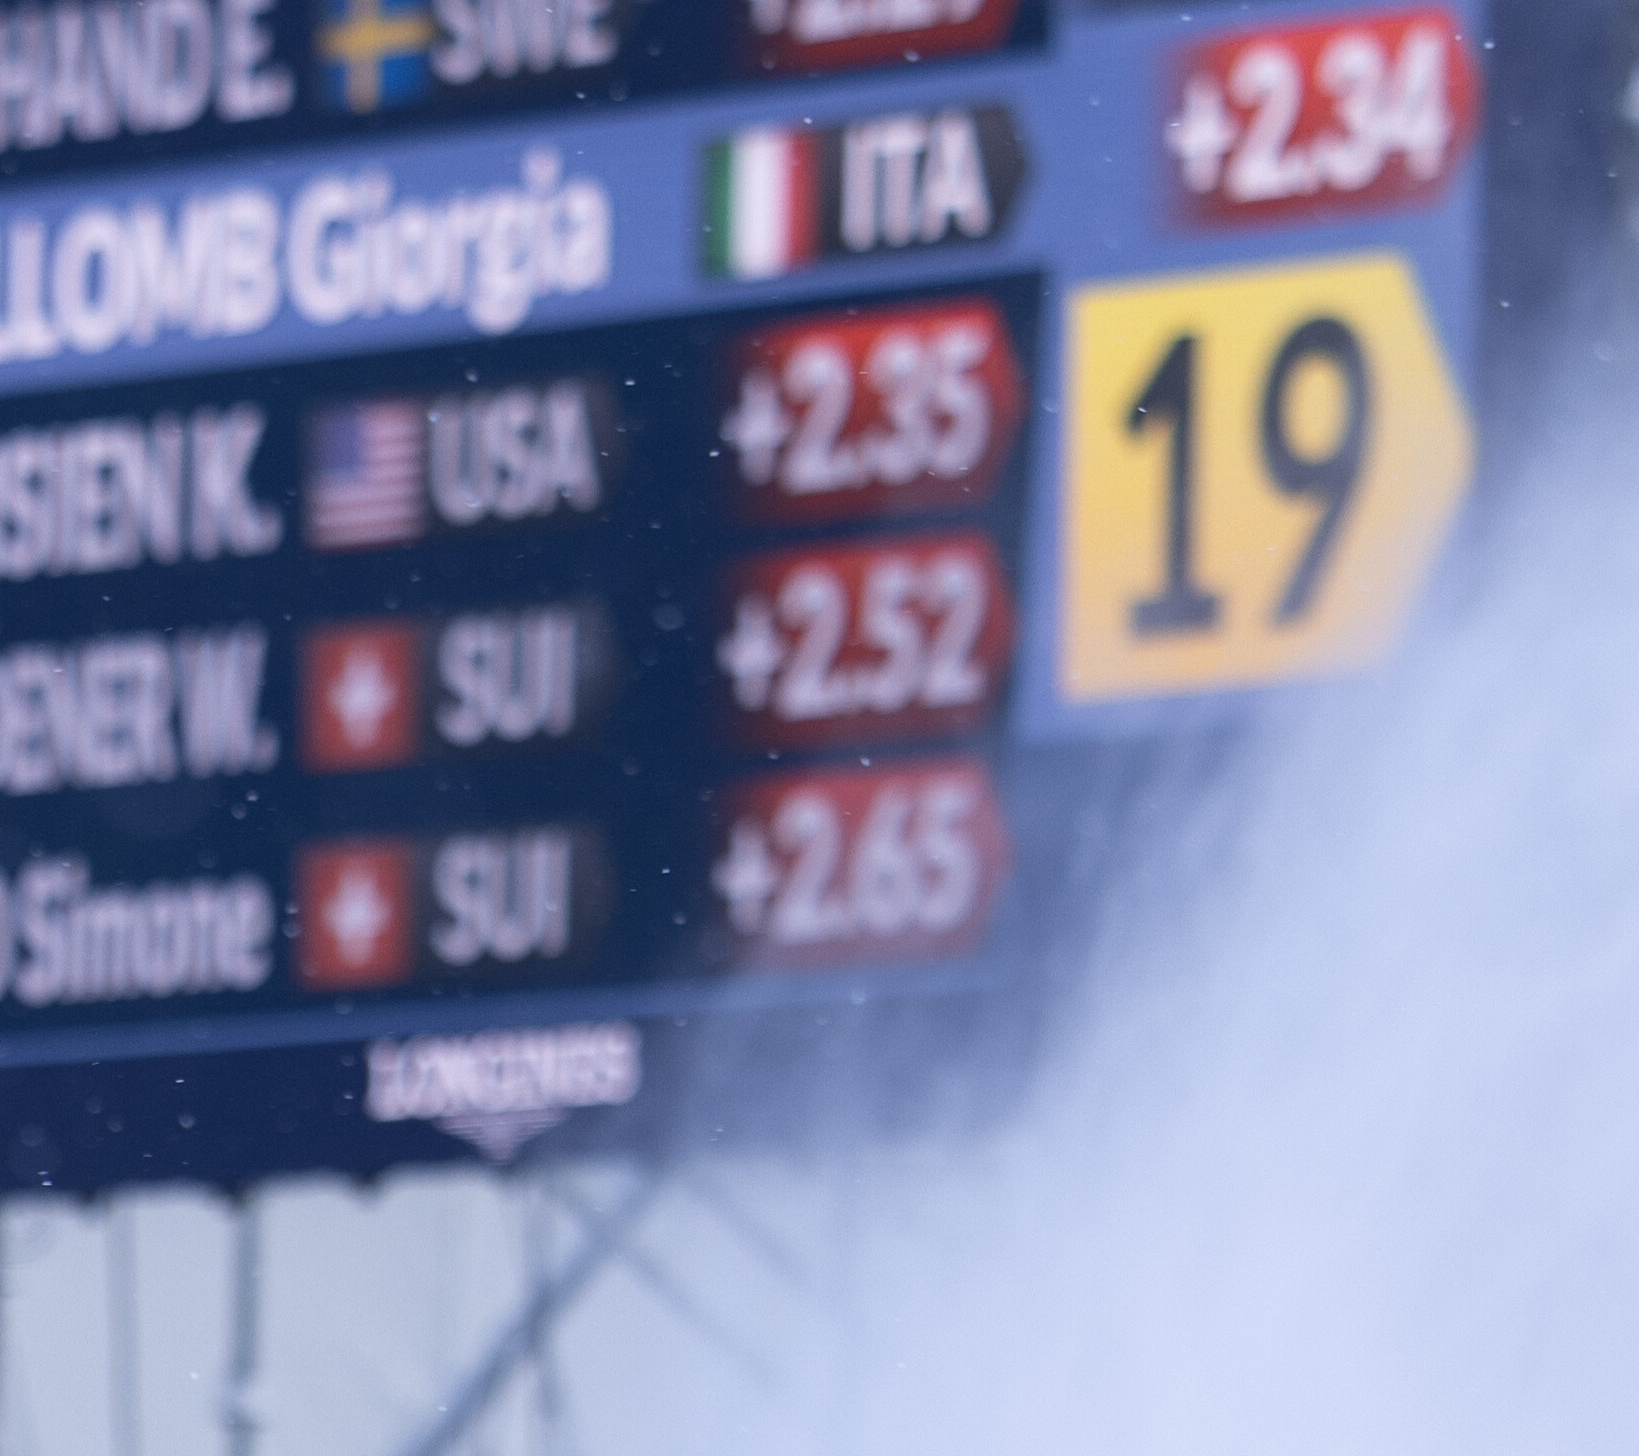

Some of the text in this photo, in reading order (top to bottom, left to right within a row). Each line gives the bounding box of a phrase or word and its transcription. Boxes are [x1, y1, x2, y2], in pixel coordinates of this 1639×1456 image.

[290, 146, 608, 333] Giorgia
[842, 112, 988, 251] ITA
[1164, 26, 1452, 202] +2.34
[191, 411, 281, 558] K.
[432, 378, 602, 524] USA
[723, 326, 992, 497] +2.35
[1125, 314, 1375, 640] 19
[436, 612, 578, 745] SUI
[722, 554, 988, 722] +2.52
[17, 854, 273, 1007] Simone
[432, 833, 572, 964] SUI
[715, 777, 979, 943] +2.65
